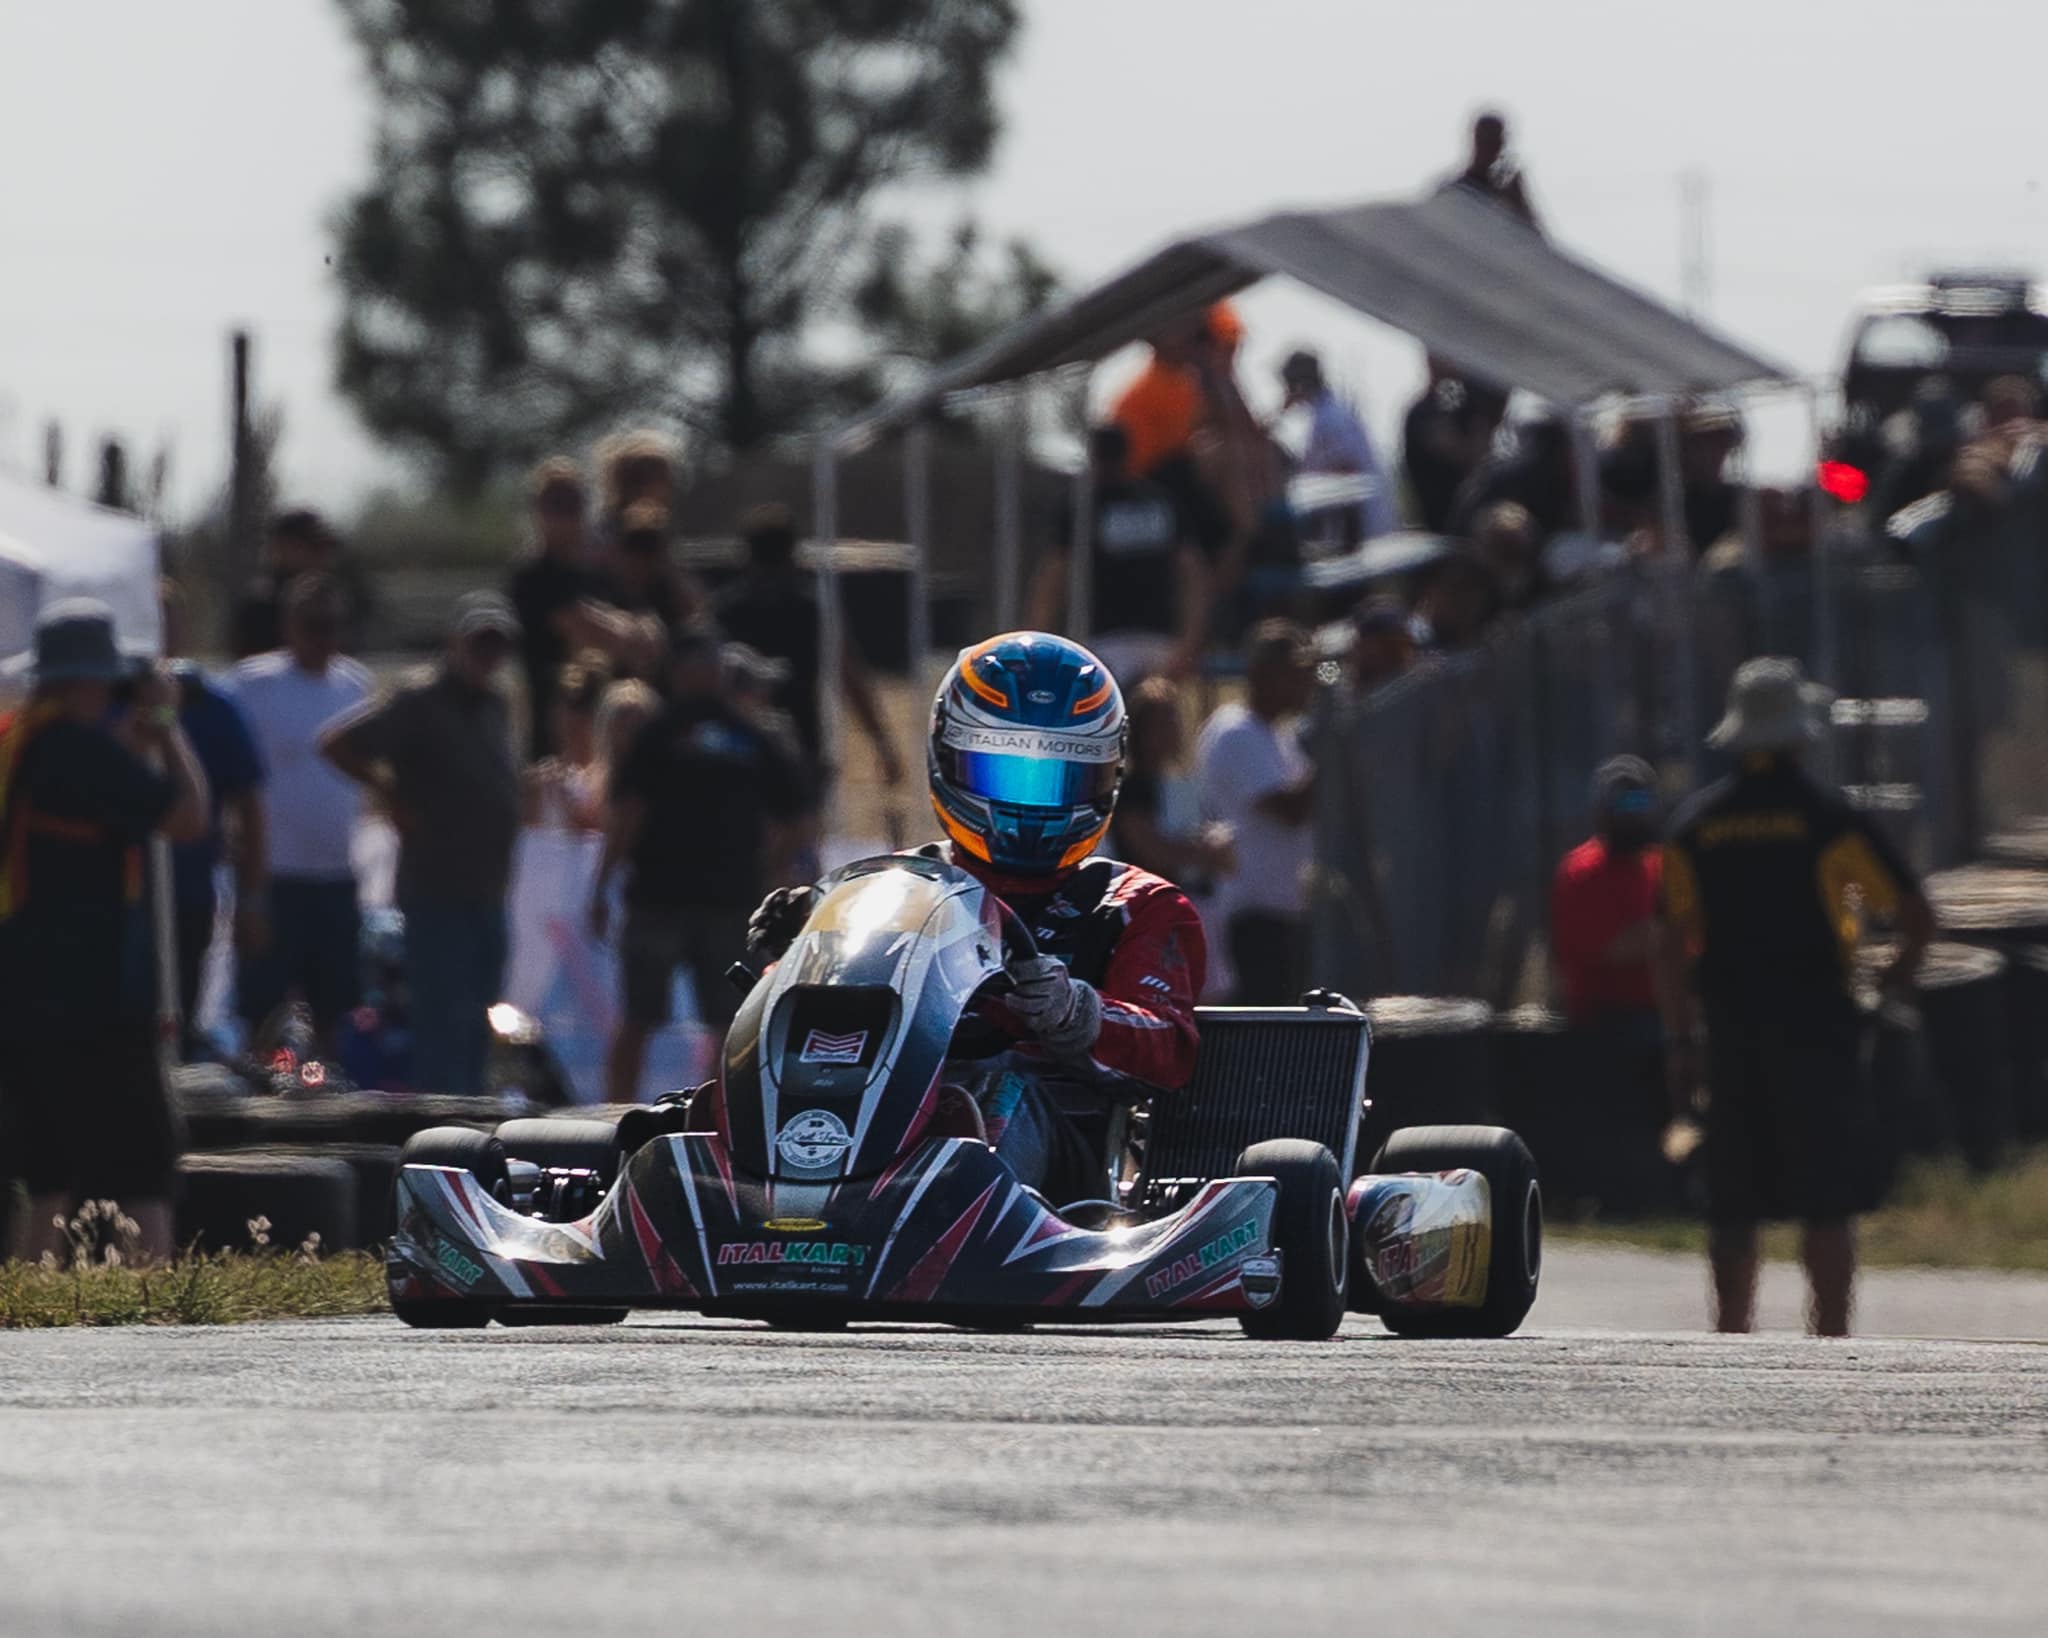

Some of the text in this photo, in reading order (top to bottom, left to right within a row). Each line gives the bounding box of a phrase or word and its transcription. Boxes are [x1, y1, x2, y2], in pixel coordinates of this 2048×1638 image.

[968, 733, 1104, 757] ITALIAN MOTORS
[716, 1241, 870, 1266] ITALKART
[1145, 1218, 1259, 1298] ITALKART
